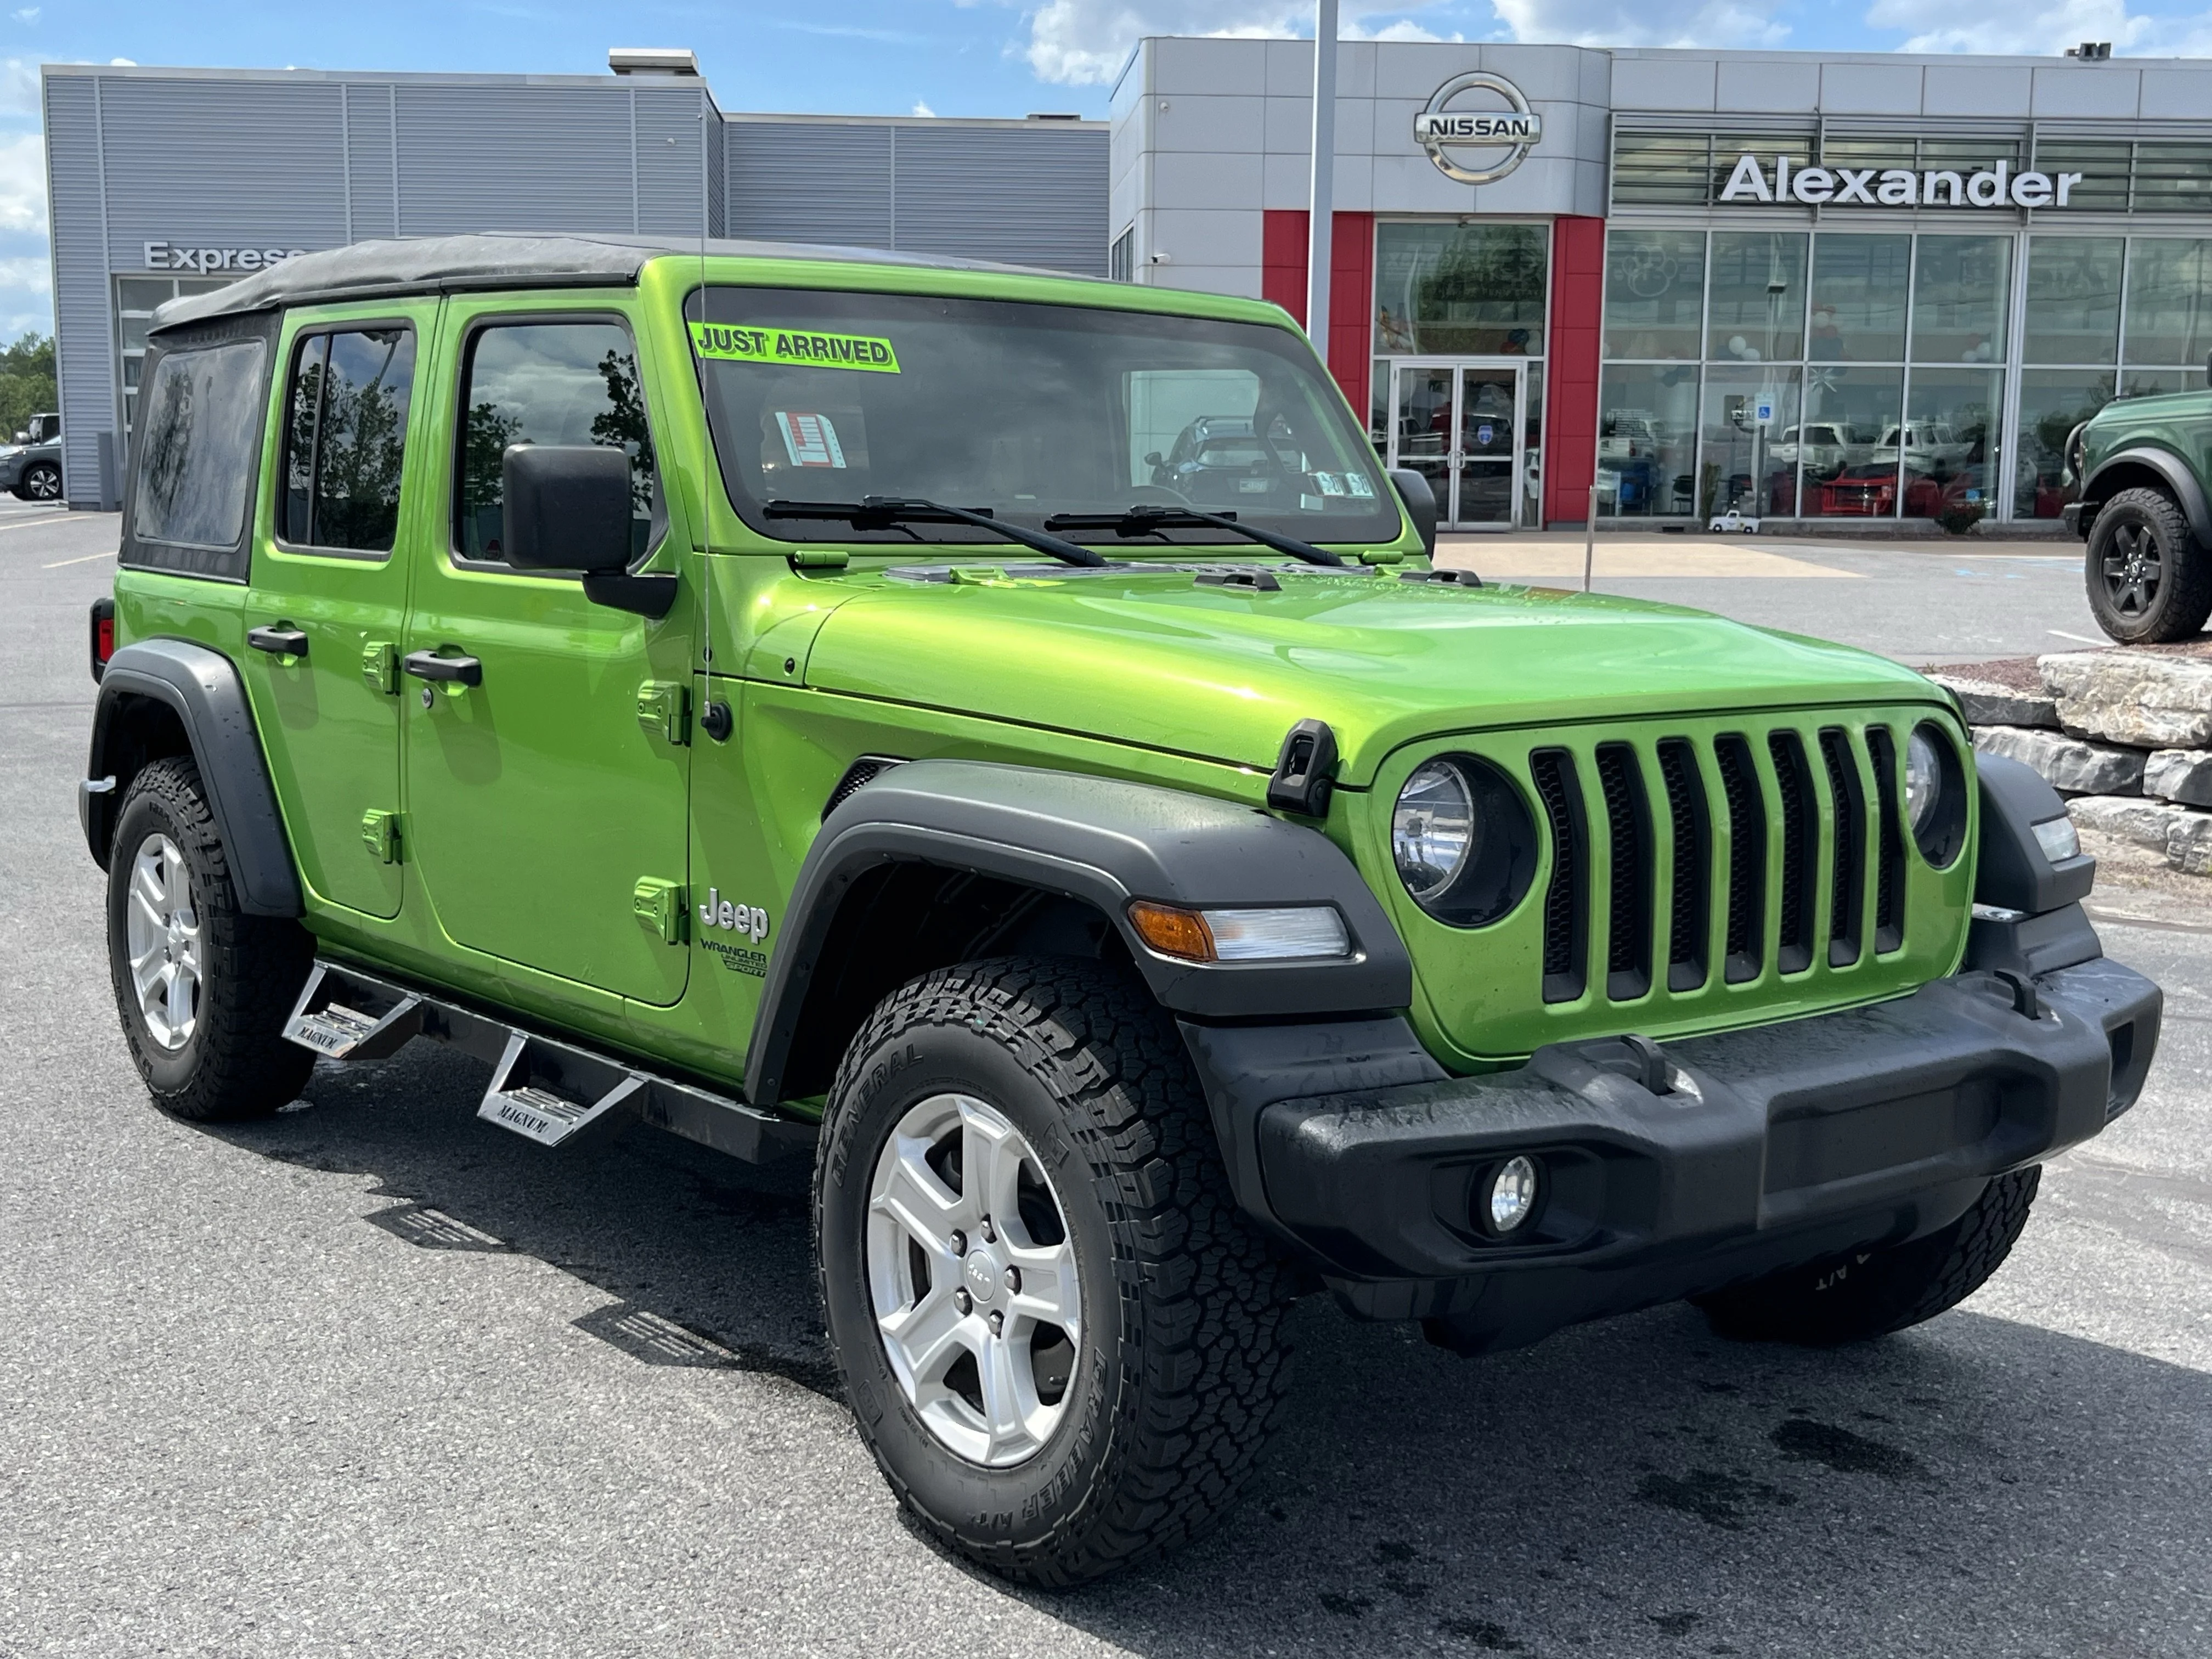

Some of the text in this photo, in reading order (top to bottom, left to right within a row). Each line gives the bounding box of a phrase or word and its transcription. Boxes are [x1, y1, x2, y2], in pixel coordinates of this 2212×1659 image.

[1429, 119, 1529, 136] NISSAN
[1719, 155, 2082, 207] Alexander
[698, 328, 893, 366] JUST ARRIVED
[699, 887, 770, 945] Jeep
[700, 938, 766, 963] WRANGLER
[725, 961, 766, 977] SPORT
[297, 1026, 338, 1049] MAGNUM
[497, 1104, 549, 1133] MAGNUM
[831, 1043, 925, 1187] GENERAL
[1021, 1346, 1107, 1520] GRABBER
